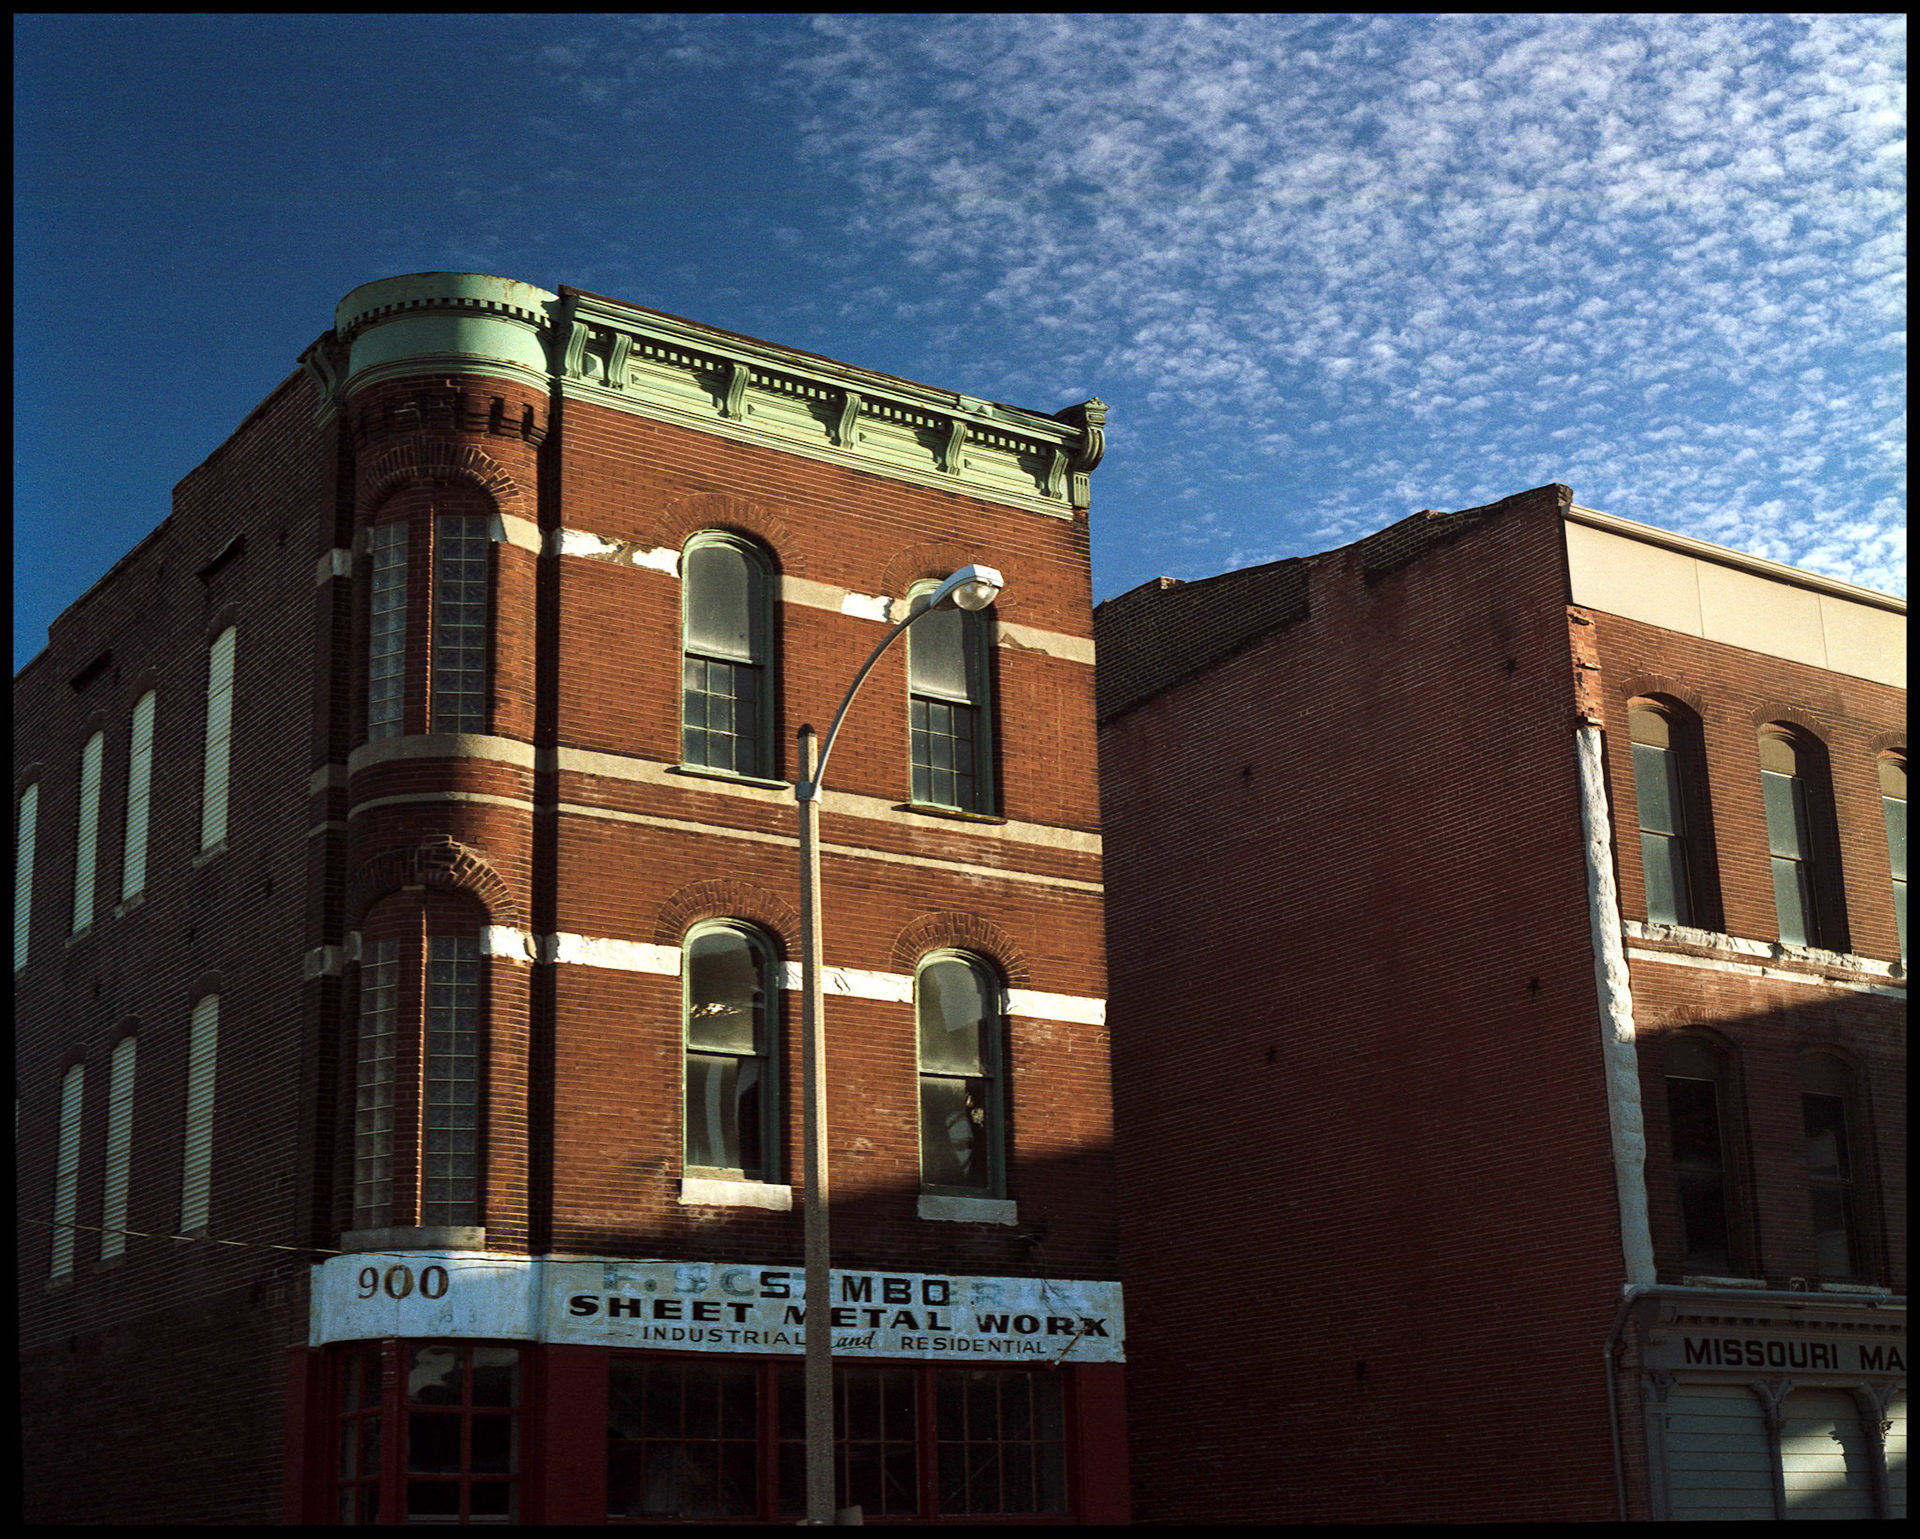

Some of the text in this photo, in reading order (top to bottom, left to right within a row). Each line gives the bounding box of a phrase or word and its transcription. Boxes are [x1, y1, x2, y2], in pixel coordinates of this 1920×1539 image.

[358, 1265, 450, 1300] 900
[759, 1271, 951, 1306] SMBO
[569, 1295, 754, 1323] SHEET
[976, 1314, 1110, 1338] WORK
[643, 1326, 1047, 1354] INDUSTRIAL and RESIDENTIAL
[1683, 1337, 1907, 1372] MISSOURI MA
